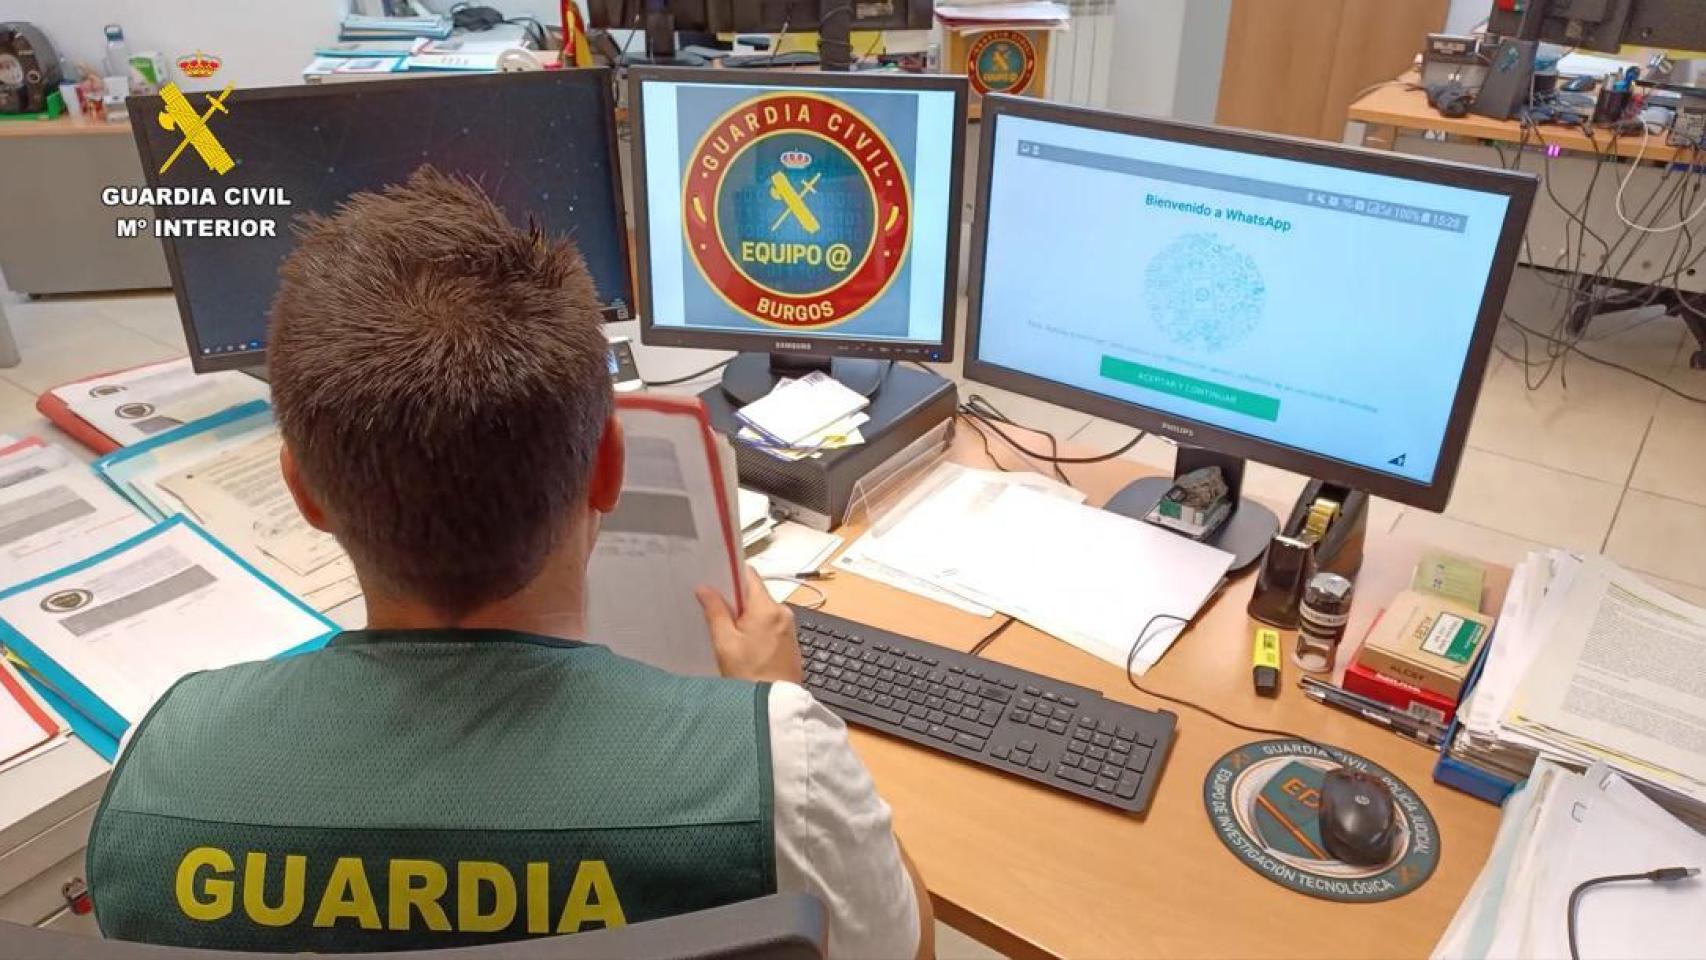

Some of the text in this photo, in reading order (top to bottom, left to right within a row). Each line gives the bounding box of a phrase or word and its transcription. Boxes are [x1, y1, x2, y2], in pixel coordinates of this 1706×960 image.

[702, 104, 889, 177] GUARDIA CIVIL
[1145, 193, 1292, 233] Bienvenido a WhatsApp
[742, 241, 852, 271] EQUIPO @
[756, 297, 835, 321] BURGOS
[1161, 422, 1194, 437] PHILIPS
[1263, 743, 1329, 758] GUARDIA
[1212, 768, 1233, 799] EQUIPO
[1213, 800, 1228, 815] DE
[175, 846, 628, 934] GUARDIA
